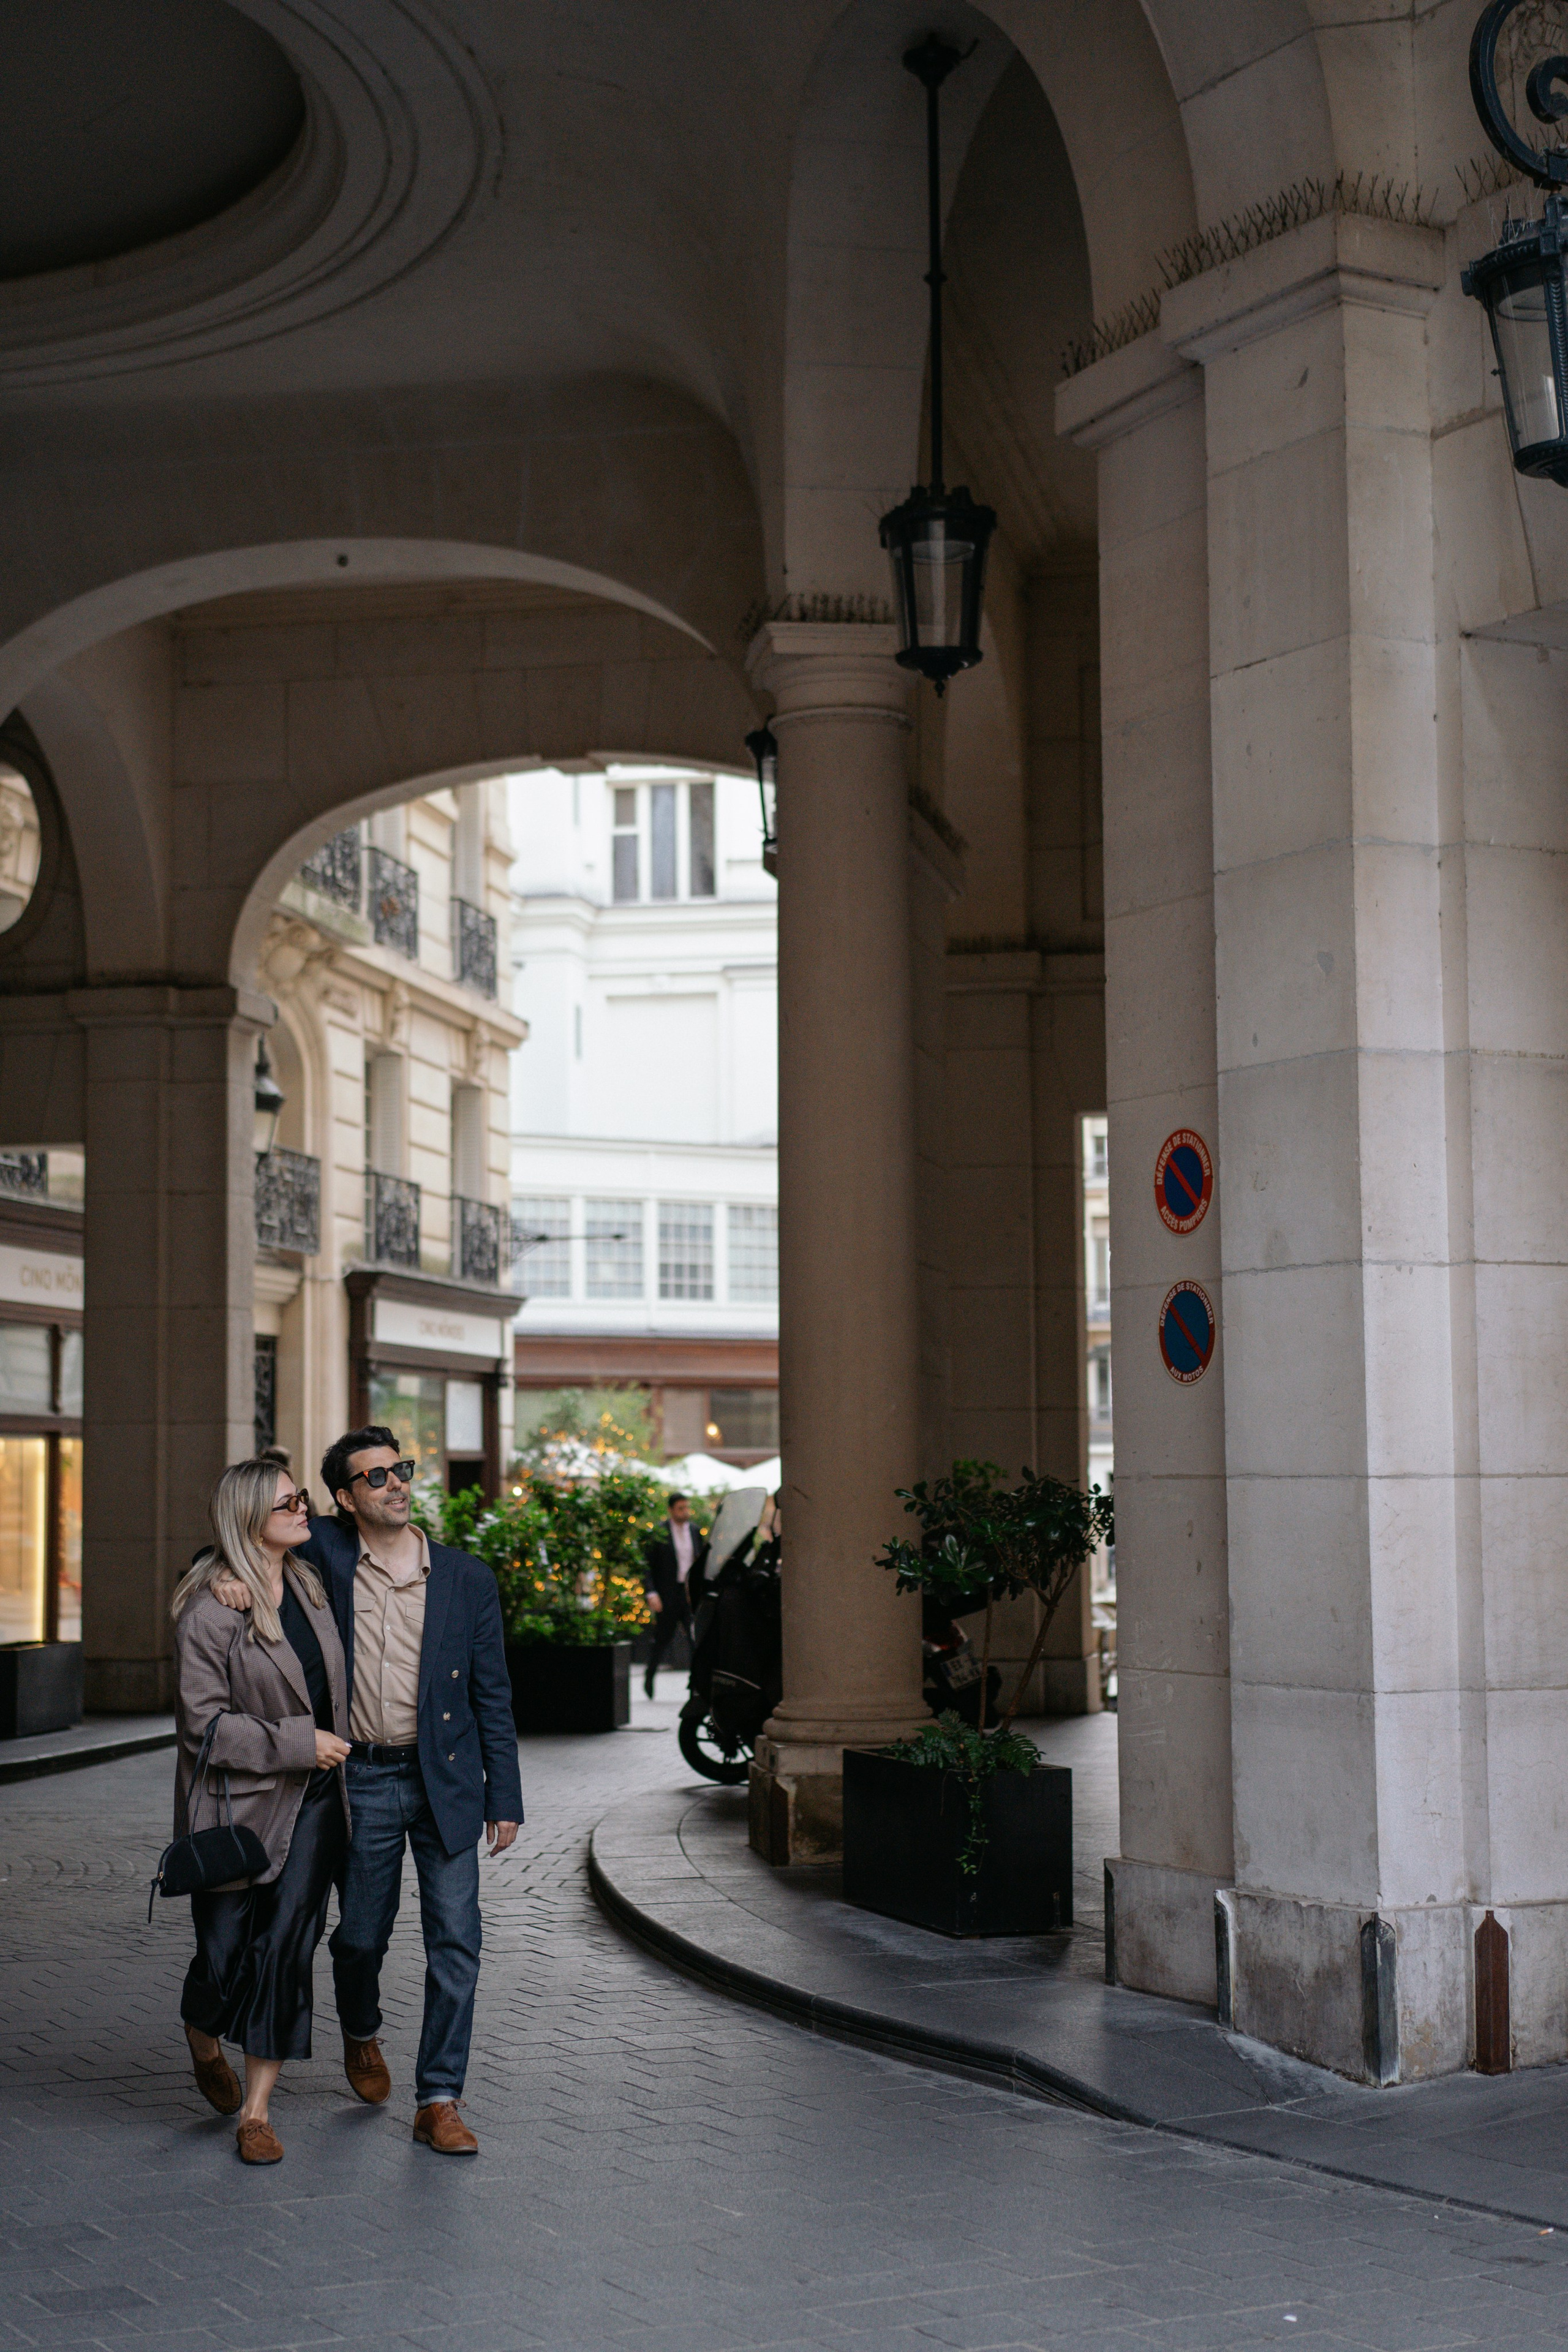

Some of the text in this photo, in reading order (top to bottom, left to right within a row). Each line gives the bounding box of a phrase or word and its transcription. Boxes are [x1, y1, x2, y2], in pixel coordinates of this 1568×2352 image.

[1156, 1132, 1211, 1185] DÉFENSE DE STATIONNER
[1160, 1199, 1207, 1231] ACCÈS POMPIERS
[1177, 1282, 1185, 1292] DE
[1186, 1281, 1213, 1324] STATIONNER
[1170, 1365, 1204, 1381] AUX MOTOS
